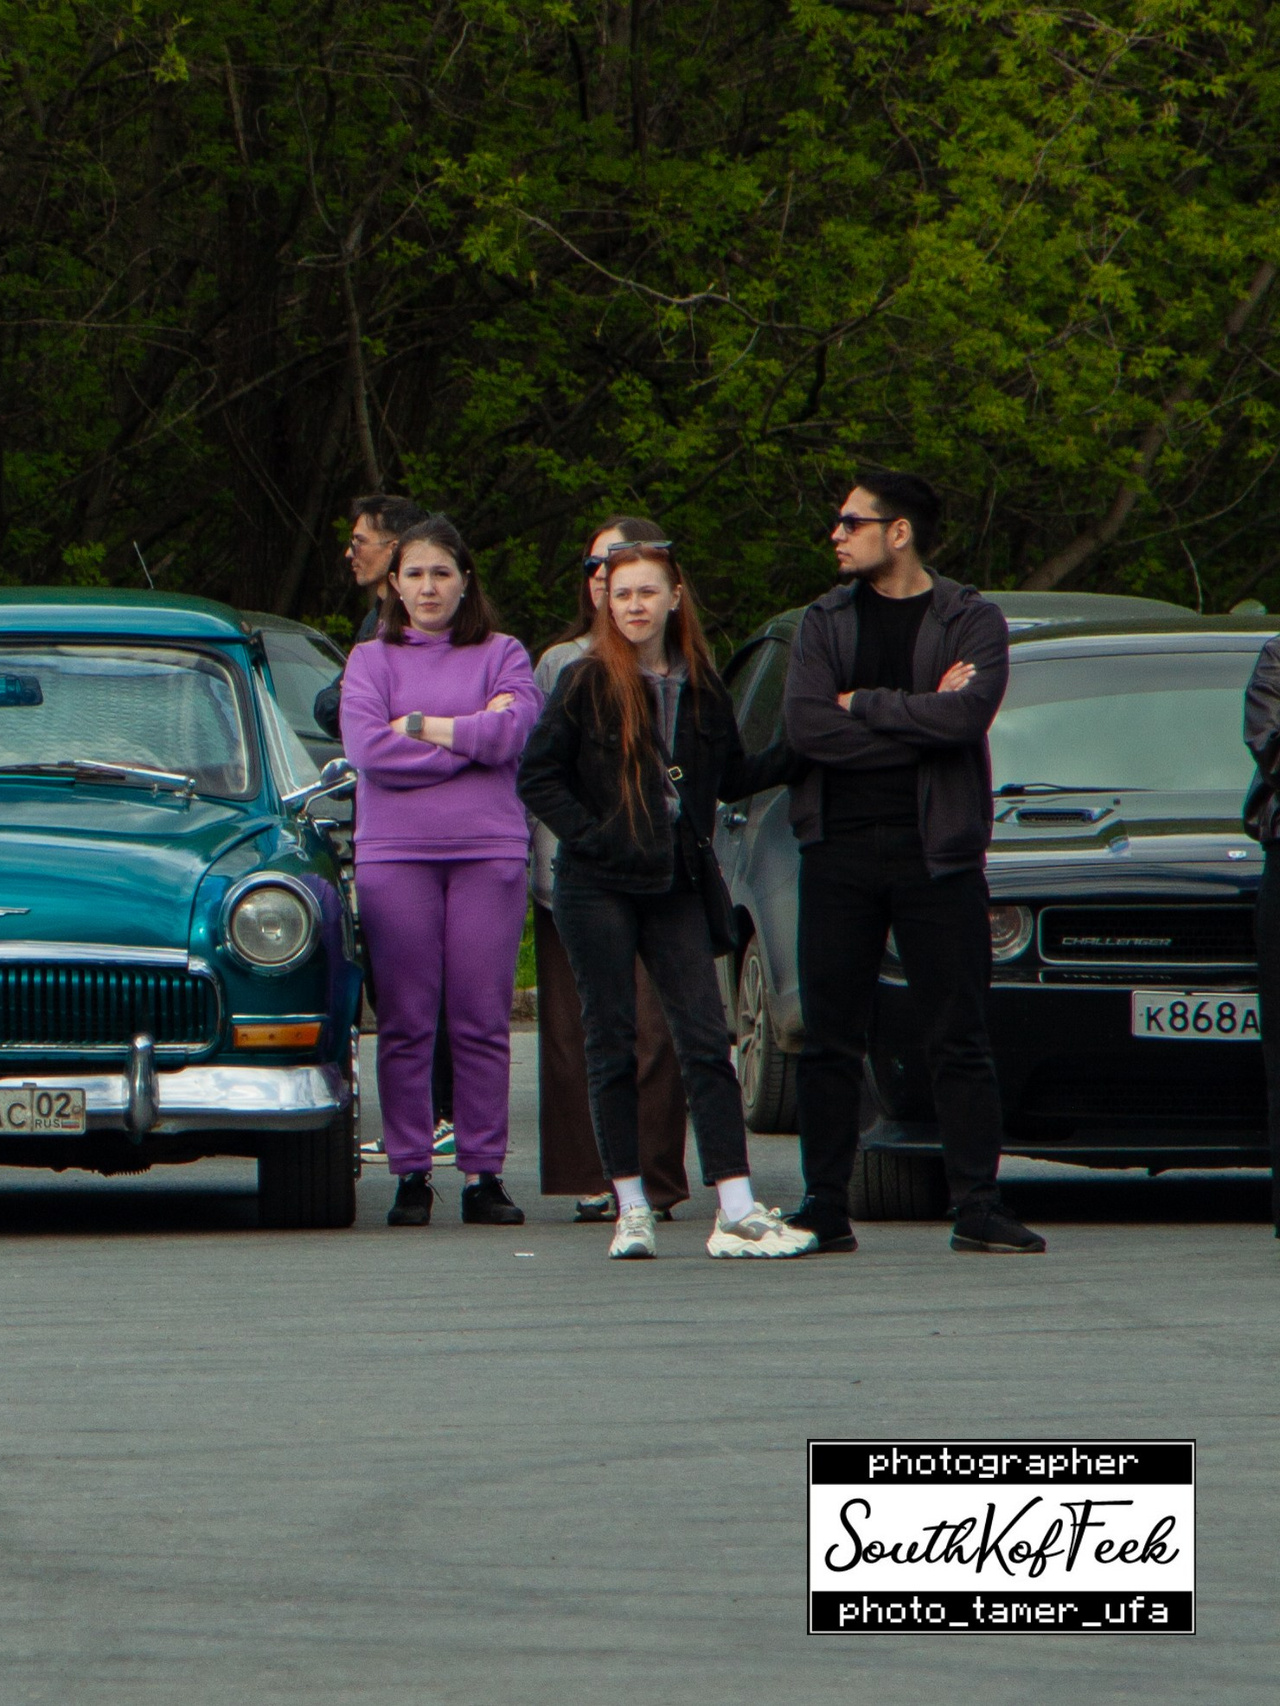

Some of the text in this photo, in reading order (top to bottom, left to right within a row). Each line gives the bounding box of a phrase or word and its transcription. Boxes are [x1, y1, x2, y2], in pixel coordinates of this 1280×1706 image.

[1061, 937, 1172, 946] CHALLENGER
[37, 1092, 72, 1118] 02
[35, 1118, 60, 1129] RUS
